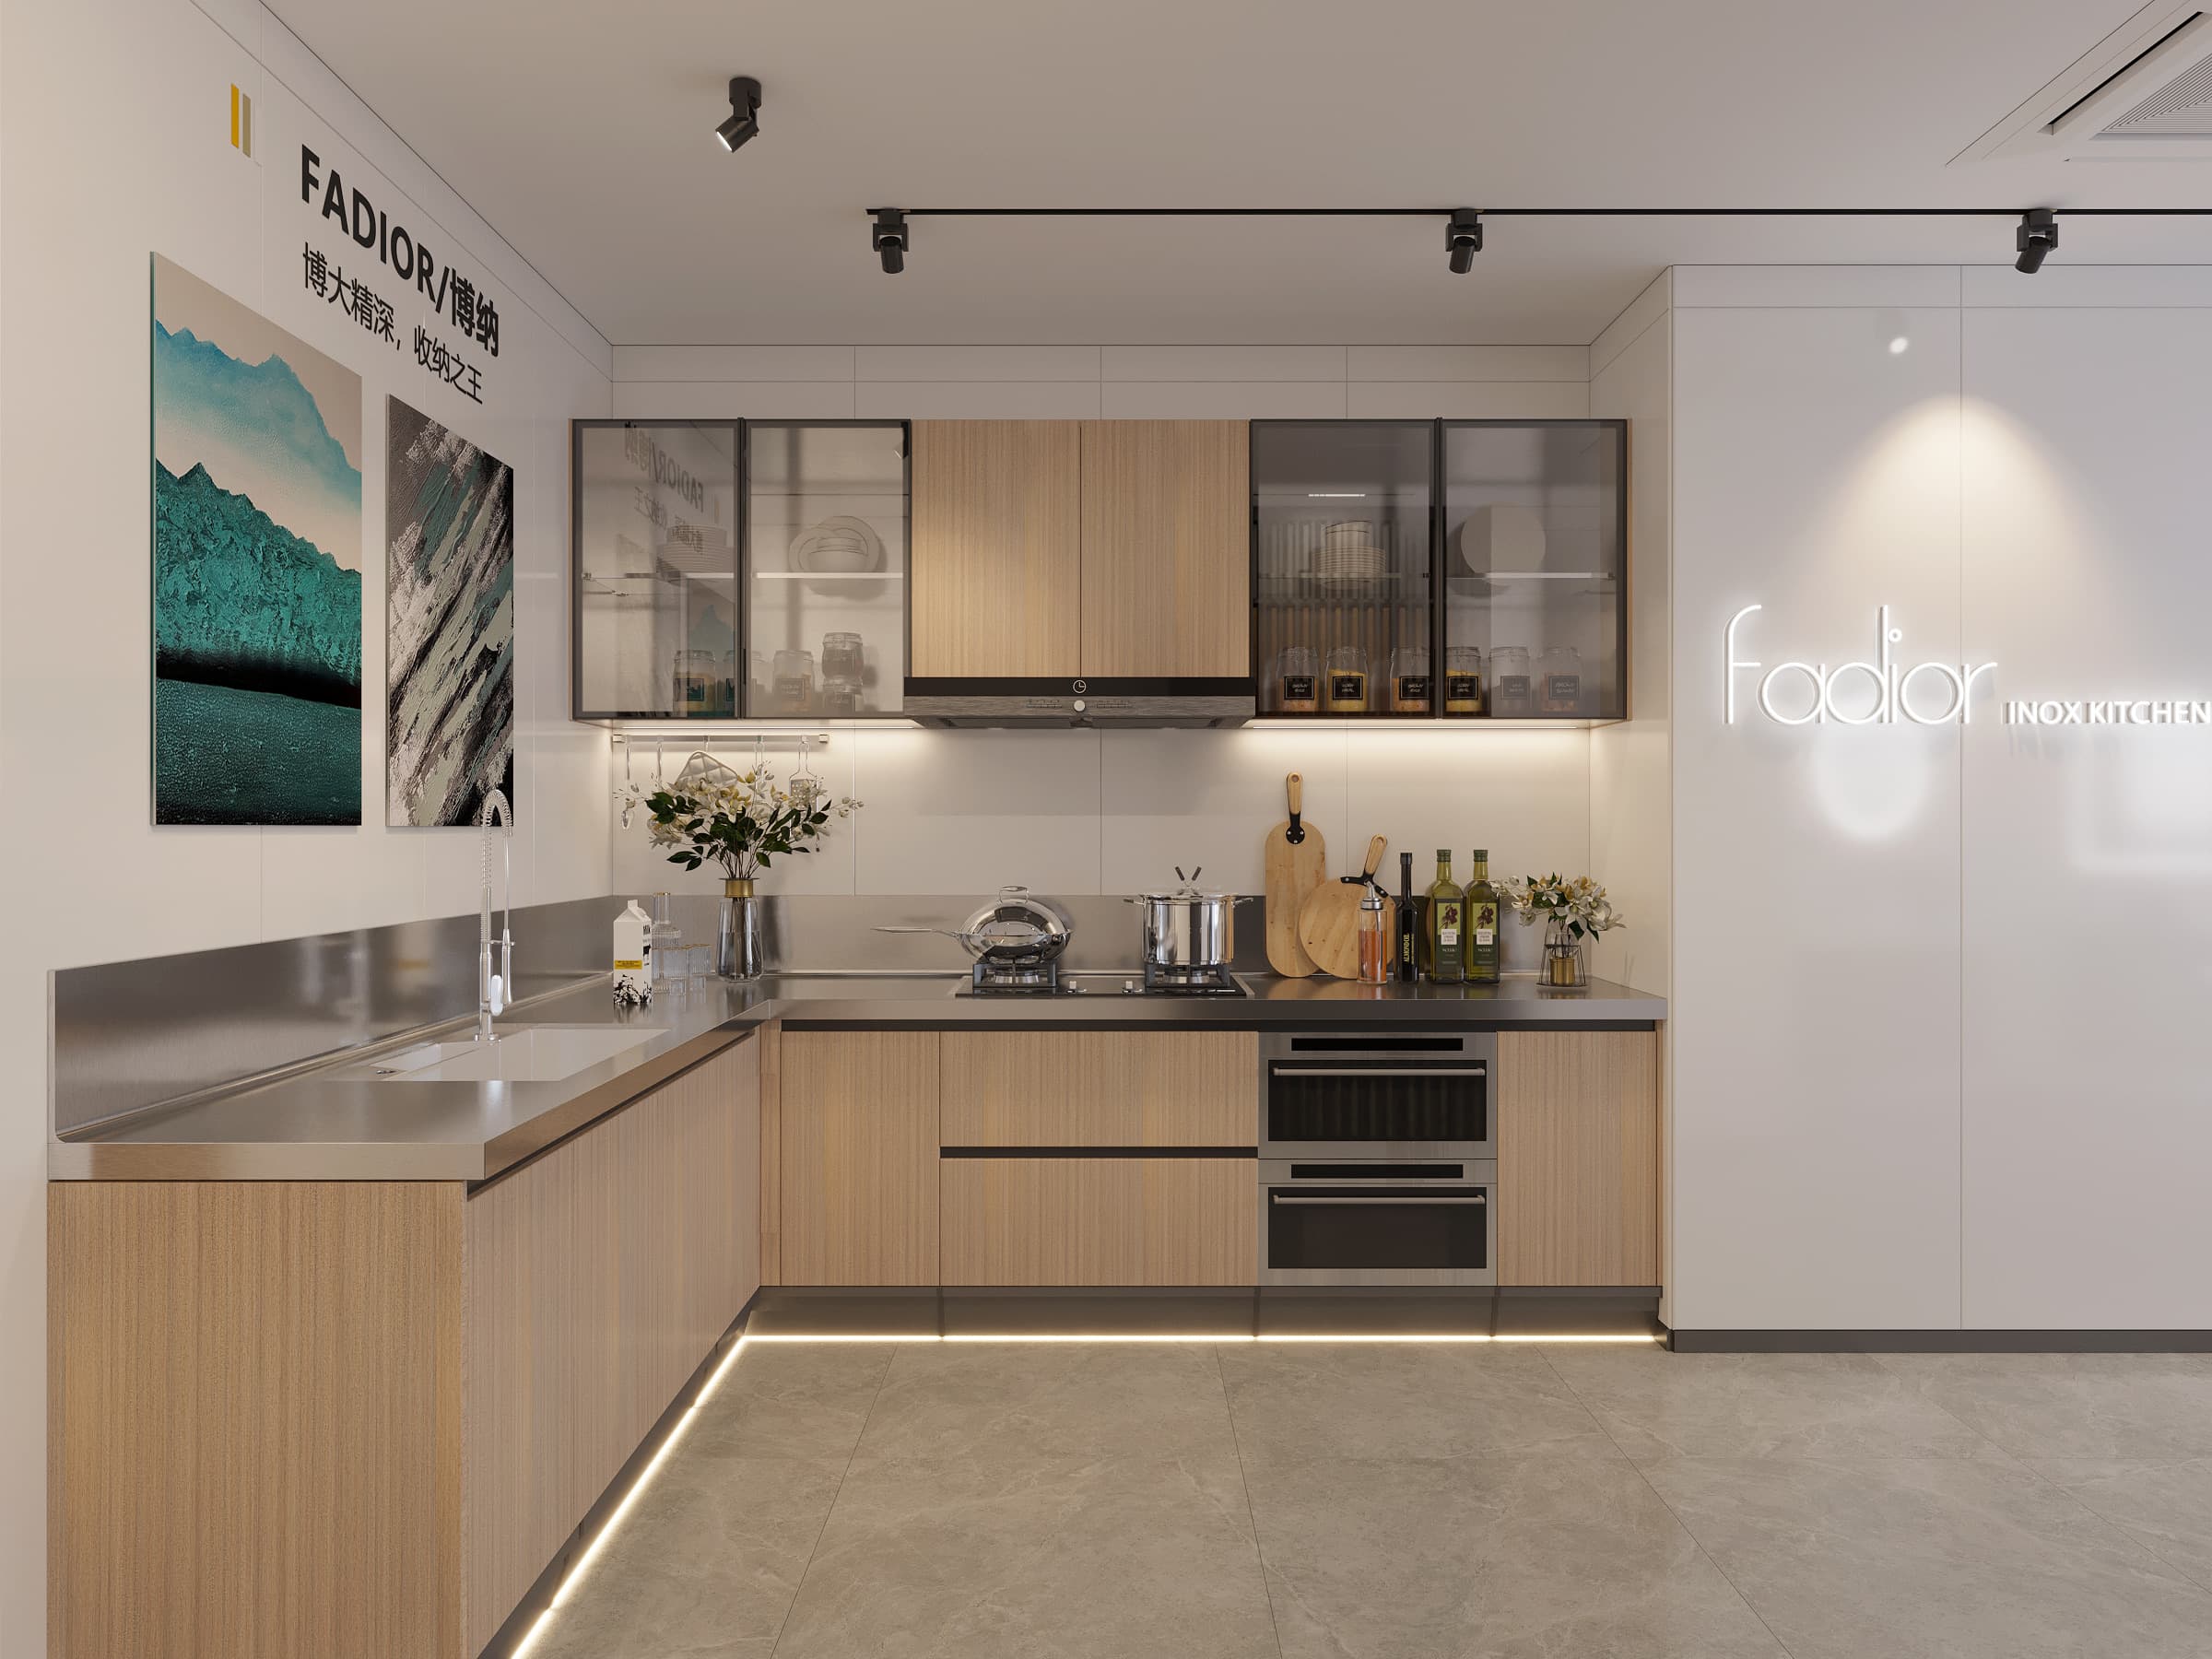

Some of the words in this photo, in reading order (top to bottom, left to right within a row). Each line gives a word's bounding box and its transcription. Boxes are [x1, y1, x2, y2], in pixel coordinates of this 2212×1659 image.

[300, 143, 500, 358] FADIOR/博纳
[1724, 604, 1998, 725] fadior
[2007, 700, 2083, 724] INOX
[2087, 700, 2211, 724] KITCHEN
